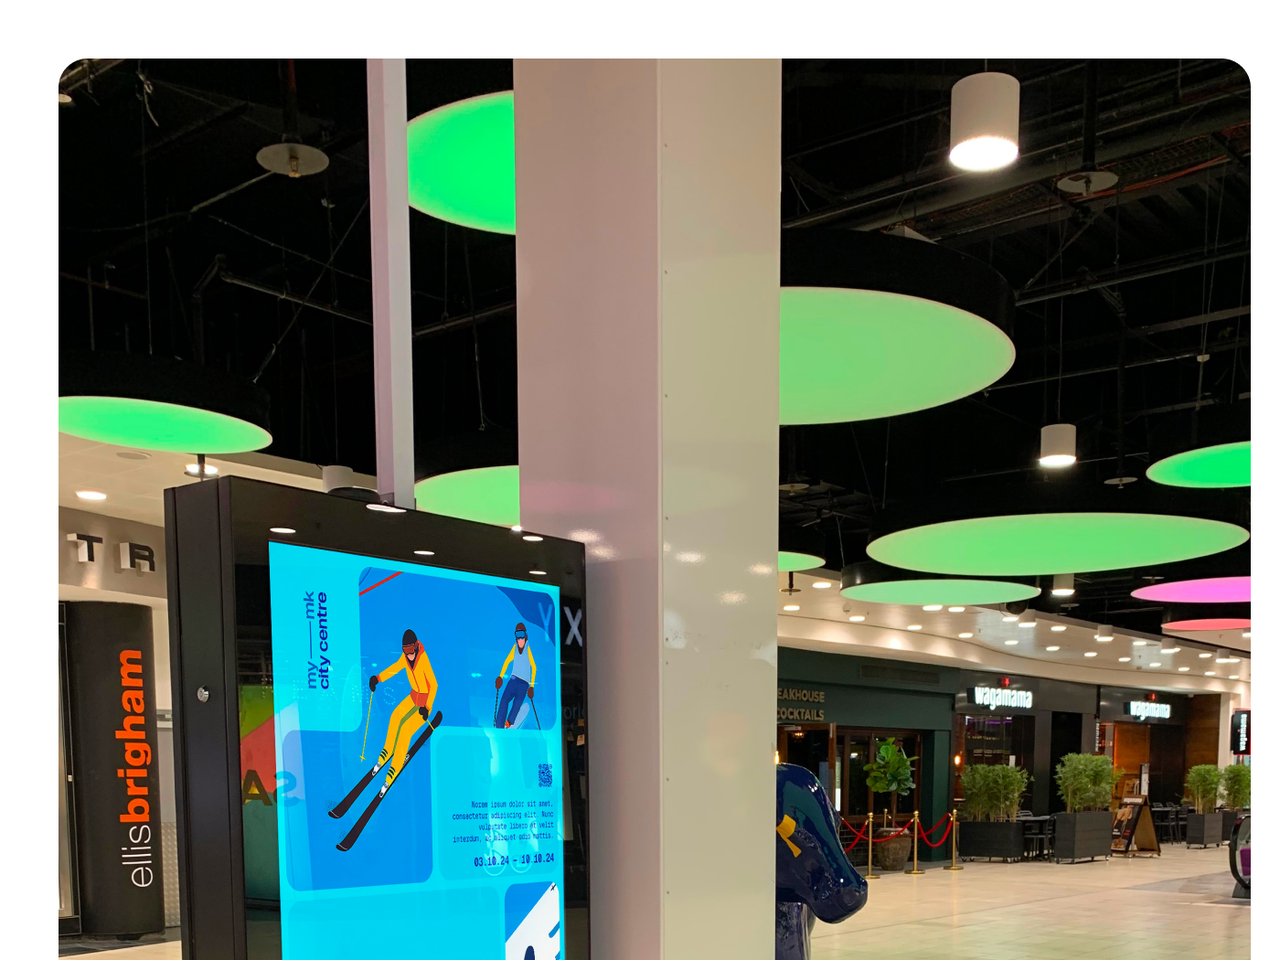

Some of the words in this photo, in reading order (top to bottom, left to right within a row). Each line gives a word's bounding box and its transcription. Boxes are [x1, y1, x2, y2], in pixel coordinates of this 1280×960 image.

[317, 592, 328, 652] centre
[318, 655, 330, 690] city
[974, 686, 1033, 710] wagamama
[1130, 700, 1171, 722] wagamama
[474, 856, 510, 867] 03.10.24
[522, 853, 554, 864] 10.10.24
